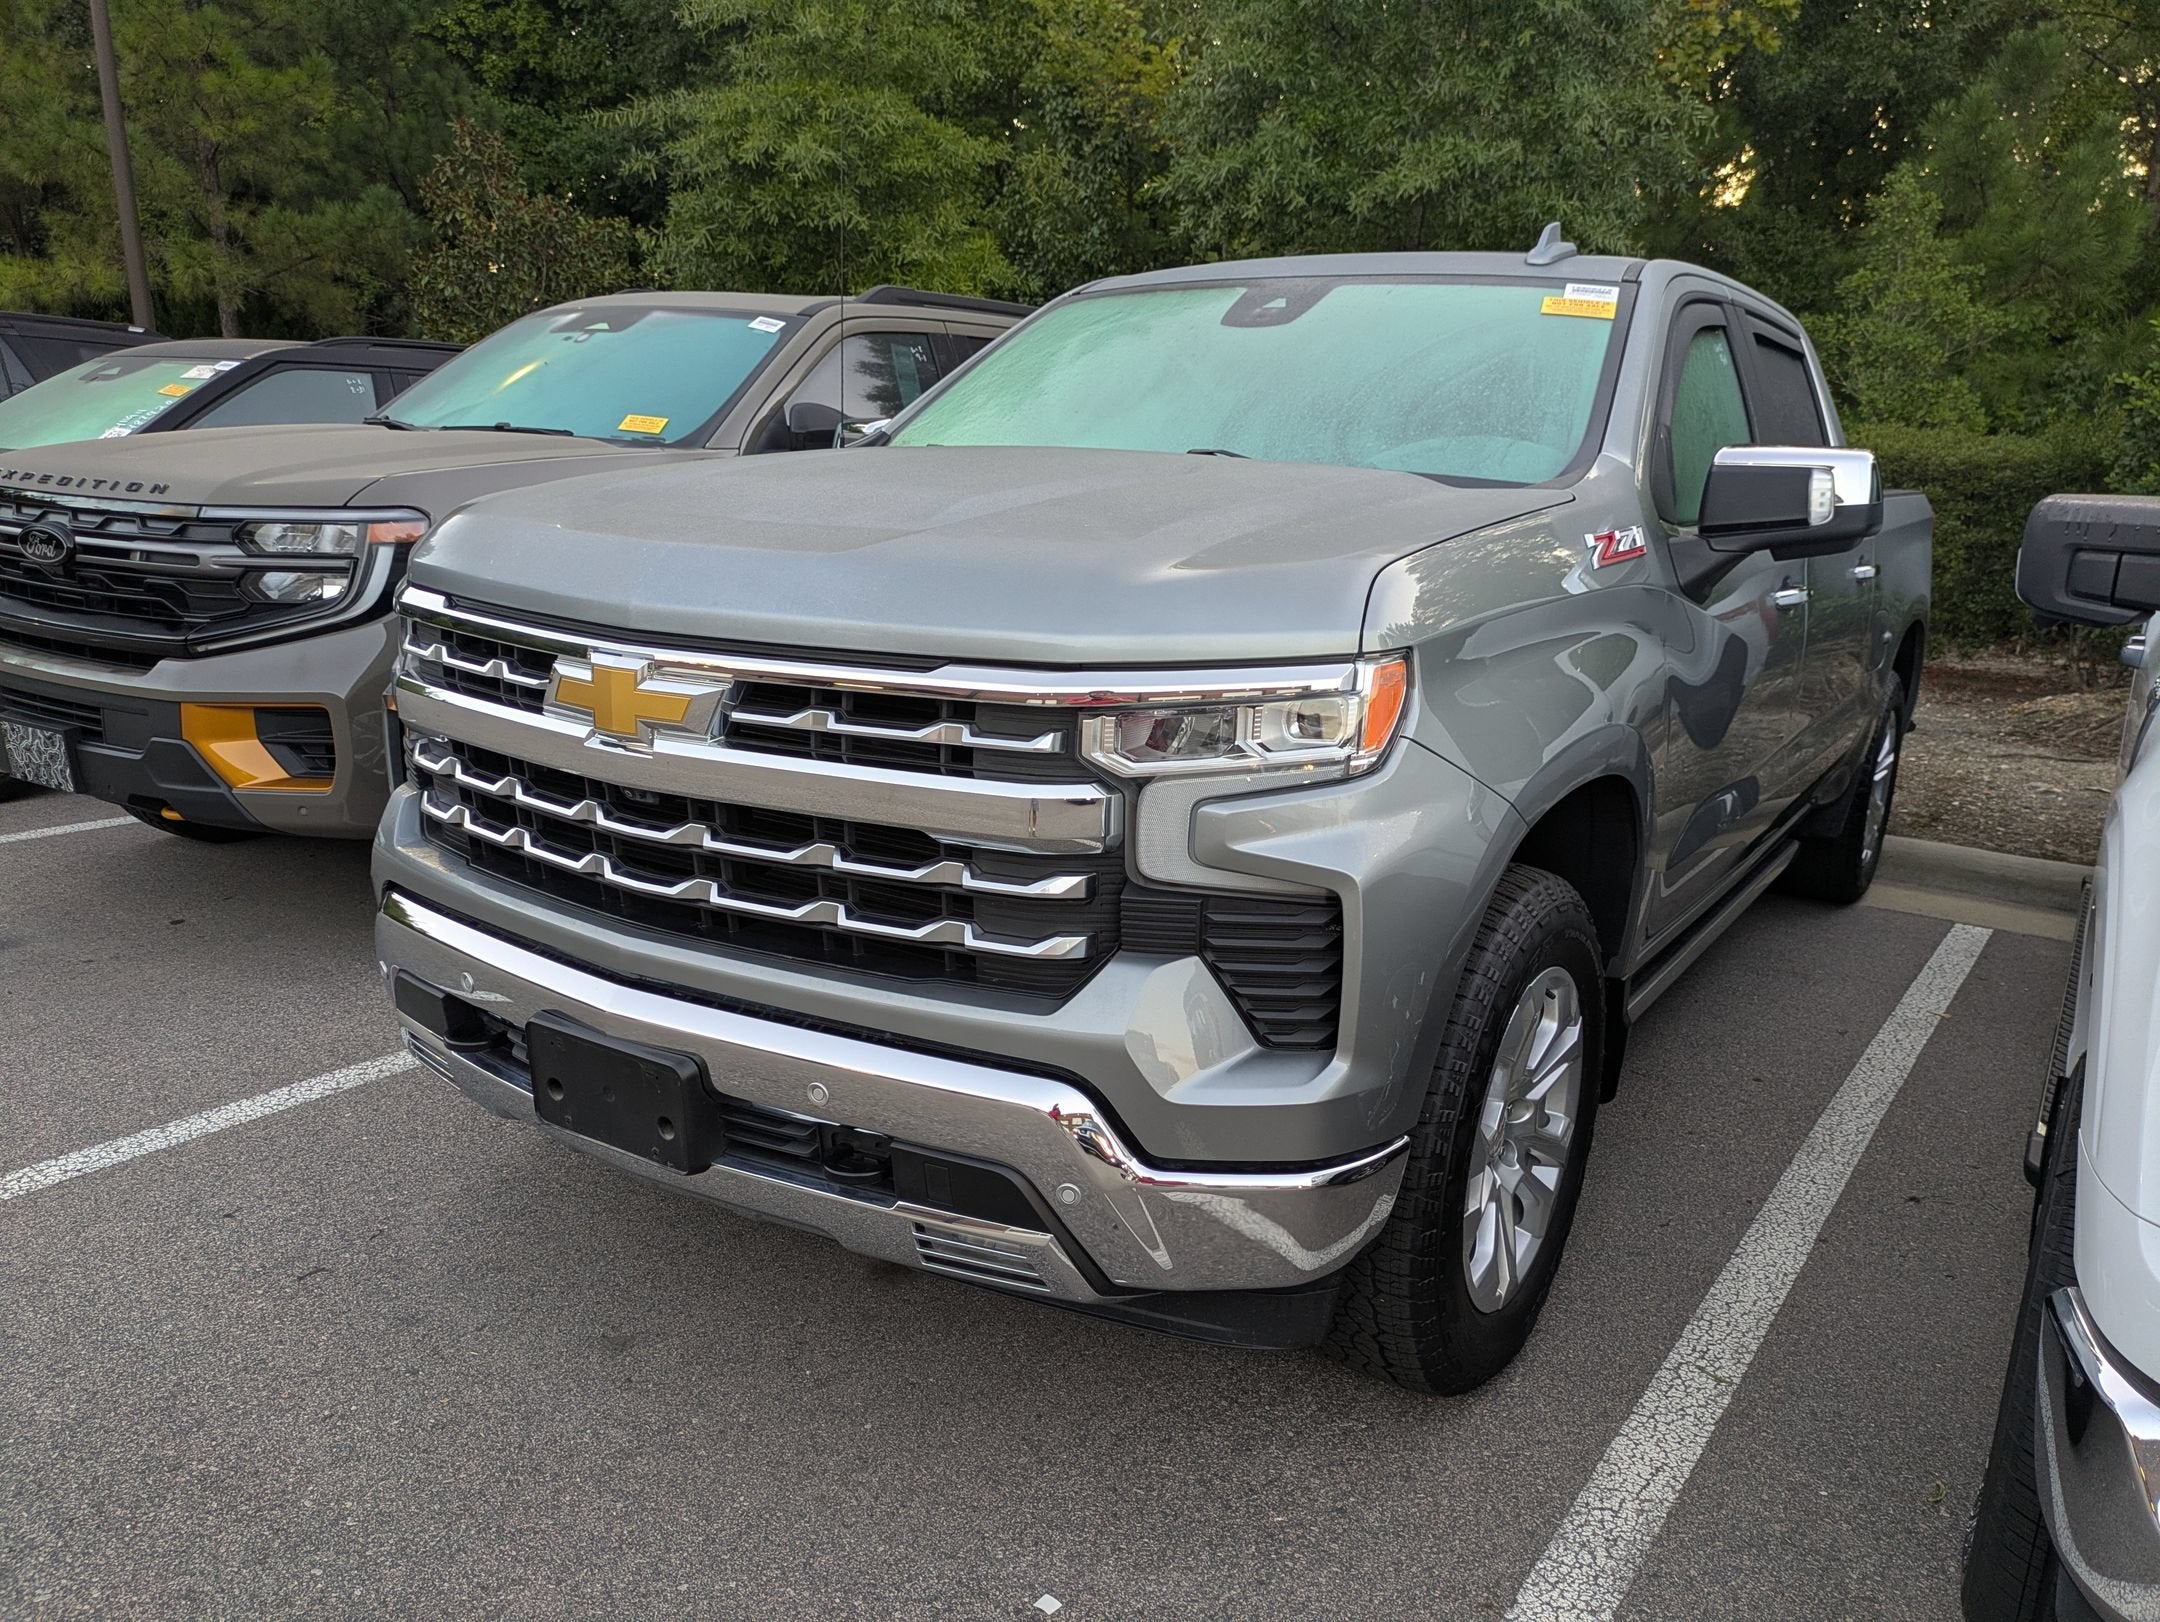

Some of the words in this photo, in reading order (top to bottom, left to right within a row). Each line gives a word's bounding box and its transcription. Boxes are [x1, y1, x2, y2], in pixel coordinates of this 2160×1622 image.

[0, 467, 170, 495] XPEDITION
[26, 531, 57, 558] Ford
[1583, 525, 1647, 571] Z71
